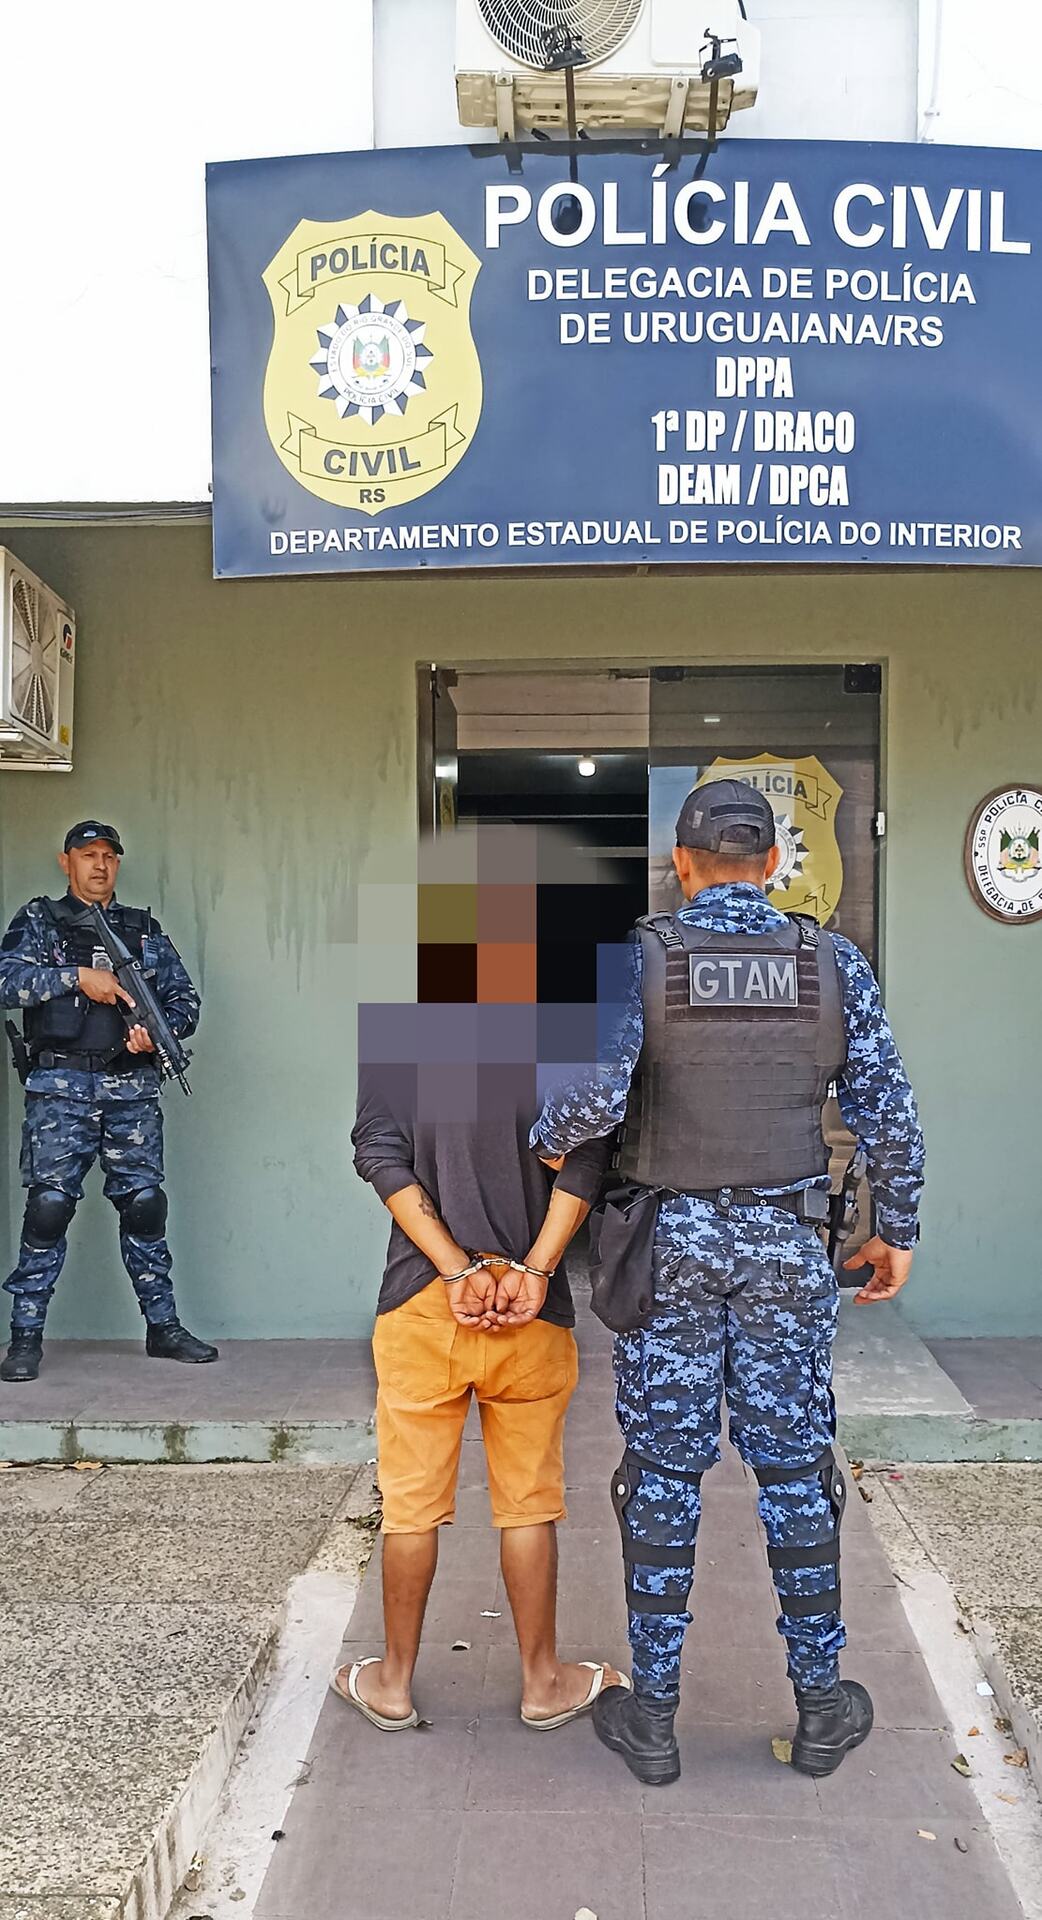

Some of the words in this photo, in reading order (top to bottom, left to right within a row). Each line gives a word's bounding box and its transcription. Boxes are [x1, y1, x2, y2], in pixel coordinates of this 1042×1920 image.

[485, 163, 811, 247] POLÍCIA
[833, 183, 1031, 254] CIVIL
[311, 237, 430, 281] POLÍCIA
[528, 267, 752, 300] DELEGACIA
[763, 268, 813, 298] DE
[826, 263, 976, 304] POLÍCIA
[560, 313, 611, 344] DE
[624, 311, 944, 347] URUGUAIANA/RS
[715, 356, 794, 399] DPPA
[651, 410, 679, 452] 1ª
[686, 410, 725, 452] DP
[731, 410, 747, 452] /
[753, 410, 855, 453] DRACO
[323, 446, 421, 476] CIVIL
[359, 488, 386, 503] RS
[658, 464, 740, 505] DEAM
[747, 463, 763, 505] /
[769, 464, 849, 506] DPCA
[270, 523, 499, 555] DEPARTAMENTO
[508, 520, 661, 545] ESTADUAL
[669, 520, 708, 543] DE
[717, 515, 832, 545] POLÍCIA
[840, 522, 881, 545] DO
[889, 523, 1022, 550] INTERIOR
[978, 829, 987, 848] SSP
[978, 865, 1014, 911] DELEGACIA
[1021, 900, 1034, 911] DE
[693, 960, 795, 999] GTAM
